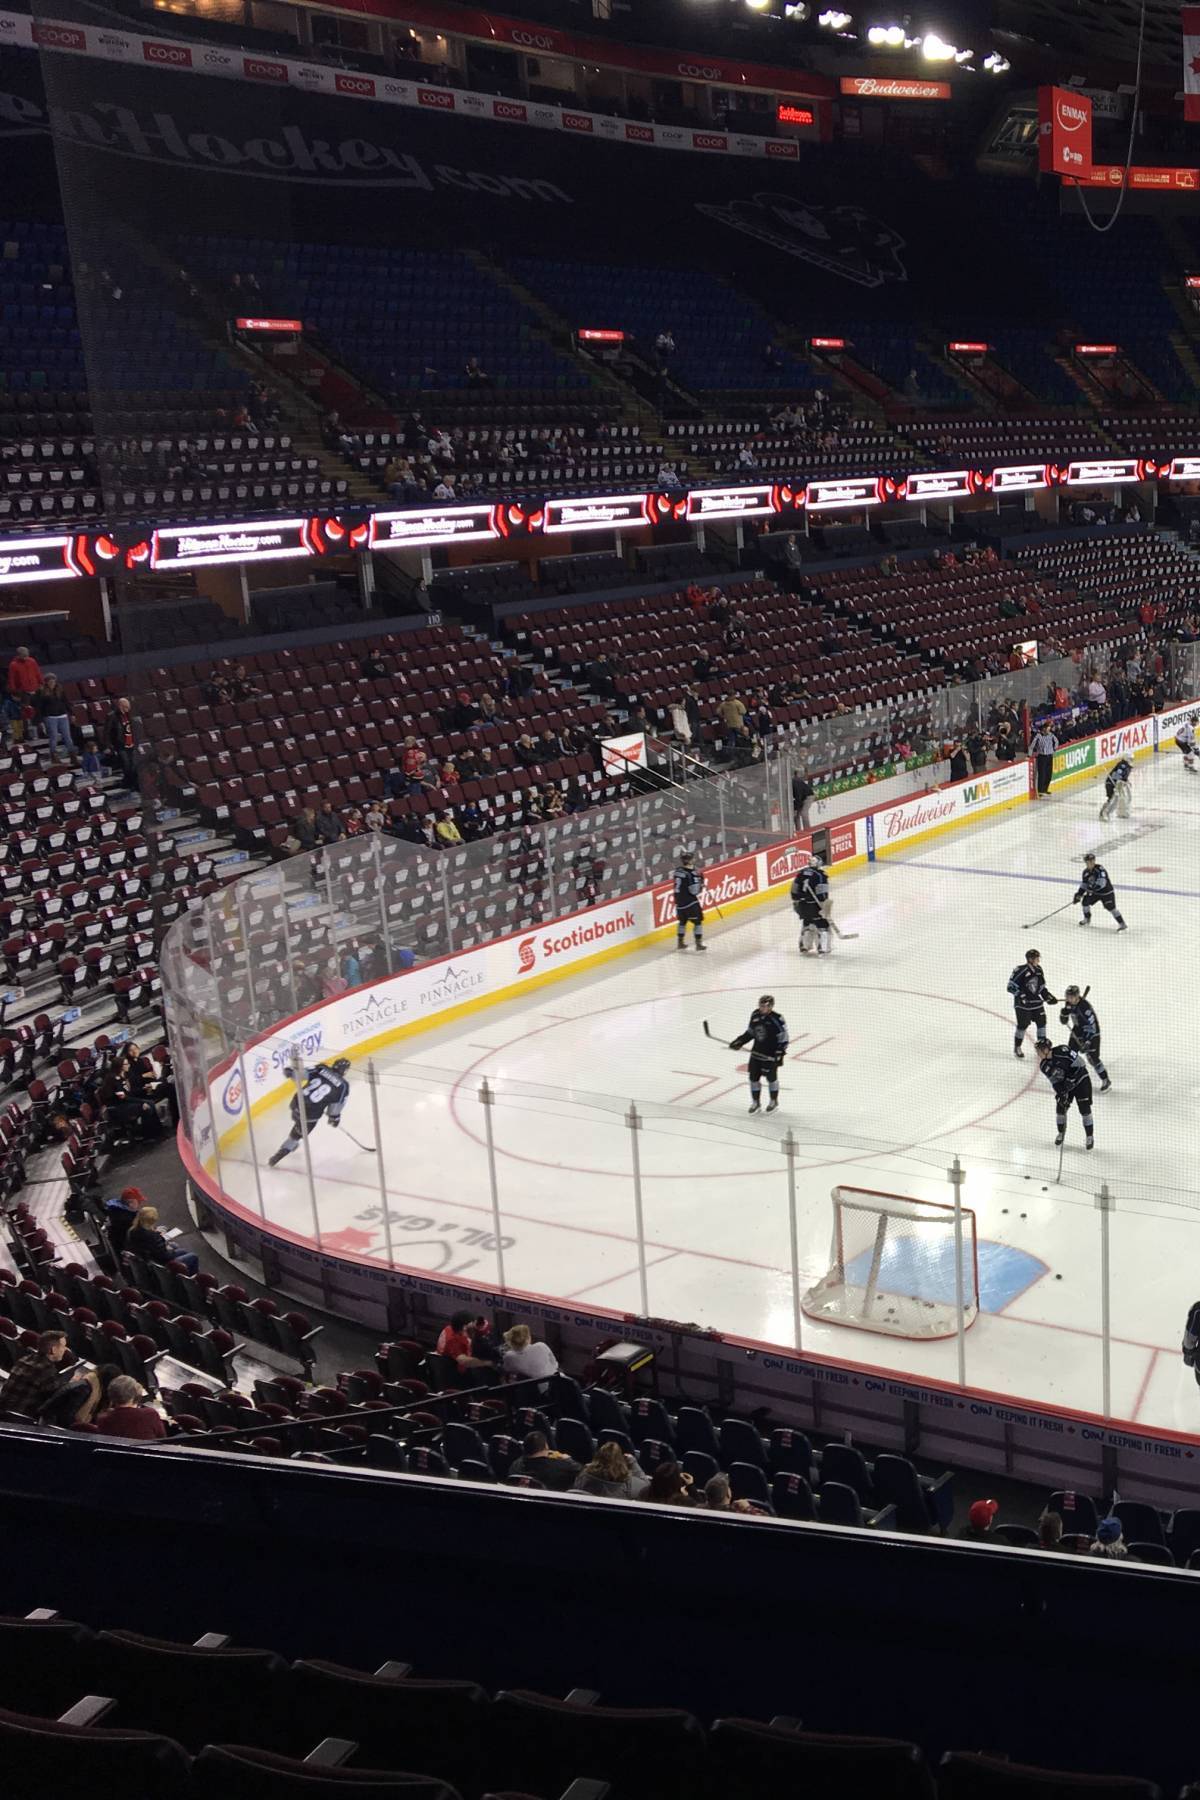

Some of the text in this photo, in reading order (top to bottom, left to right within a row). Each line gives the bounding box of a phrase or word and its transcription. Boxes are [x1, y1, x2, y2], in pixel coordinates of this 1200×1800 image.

[511, 29, 554, 48] CO-OP
[149, 47, 187, 62] CO-OP
[249, 63, 284, 78] CO-OP
[678, 63, 721, 79] CO-OP
[340, 78, 372, 91] CO-OP
[854, 78, 939, 97] Budweiser
[421, 92, 452, 106] CO-OP
[497, 104, 524, 117] CO-OP
[1062, 105, 1087, 122] ENMAX
[565, 116, 590, 128] CO-OP
[696, 136, 724, 147] CO-OP
[769, 144, 795, 153] CO-OP
[1100, 724, 1149, 759] RE/MAX
[1053, 745, 1091, 771] UBWAY
[963, 781, 991, 803] WM
[884, 799, 957, 838] Budweiser
[770, 860, 789, 879] PAPA
[543, 911, 635, 958] Scotiabank
[420, 971, 485, 1005] PINNACLE
[342, 999, 410, 1035] PINNACLE
[272, 1030, 323, 1070] Synergy
[303, 1078, 332, 1104] 28
[354, 1205, 436, 1232] GAS
[456, 1226, 516, 1252] OIL
[786, 1361, 816, 1378] KEEPING
[817, 1369, 824, 1380] IT
[825, 1372, 849, 1385] FRESH
[889, 1385, 919, 1401] KEEPING
[921, 1391, 928, 1402] IT
[930, 1394, 954, 1408] FRESH
[996, 1408, 1027, 1425] KEEPING
[1029, 1415, 1037, 1426] IT
[1039, 1418, 1064, 1433] FRESH
[1108, 1435, 1142, 1451] KEEPING
[1144, 1442, 1152, 1452] IT
[1154, 1444, 1181, 1459] FRESH
